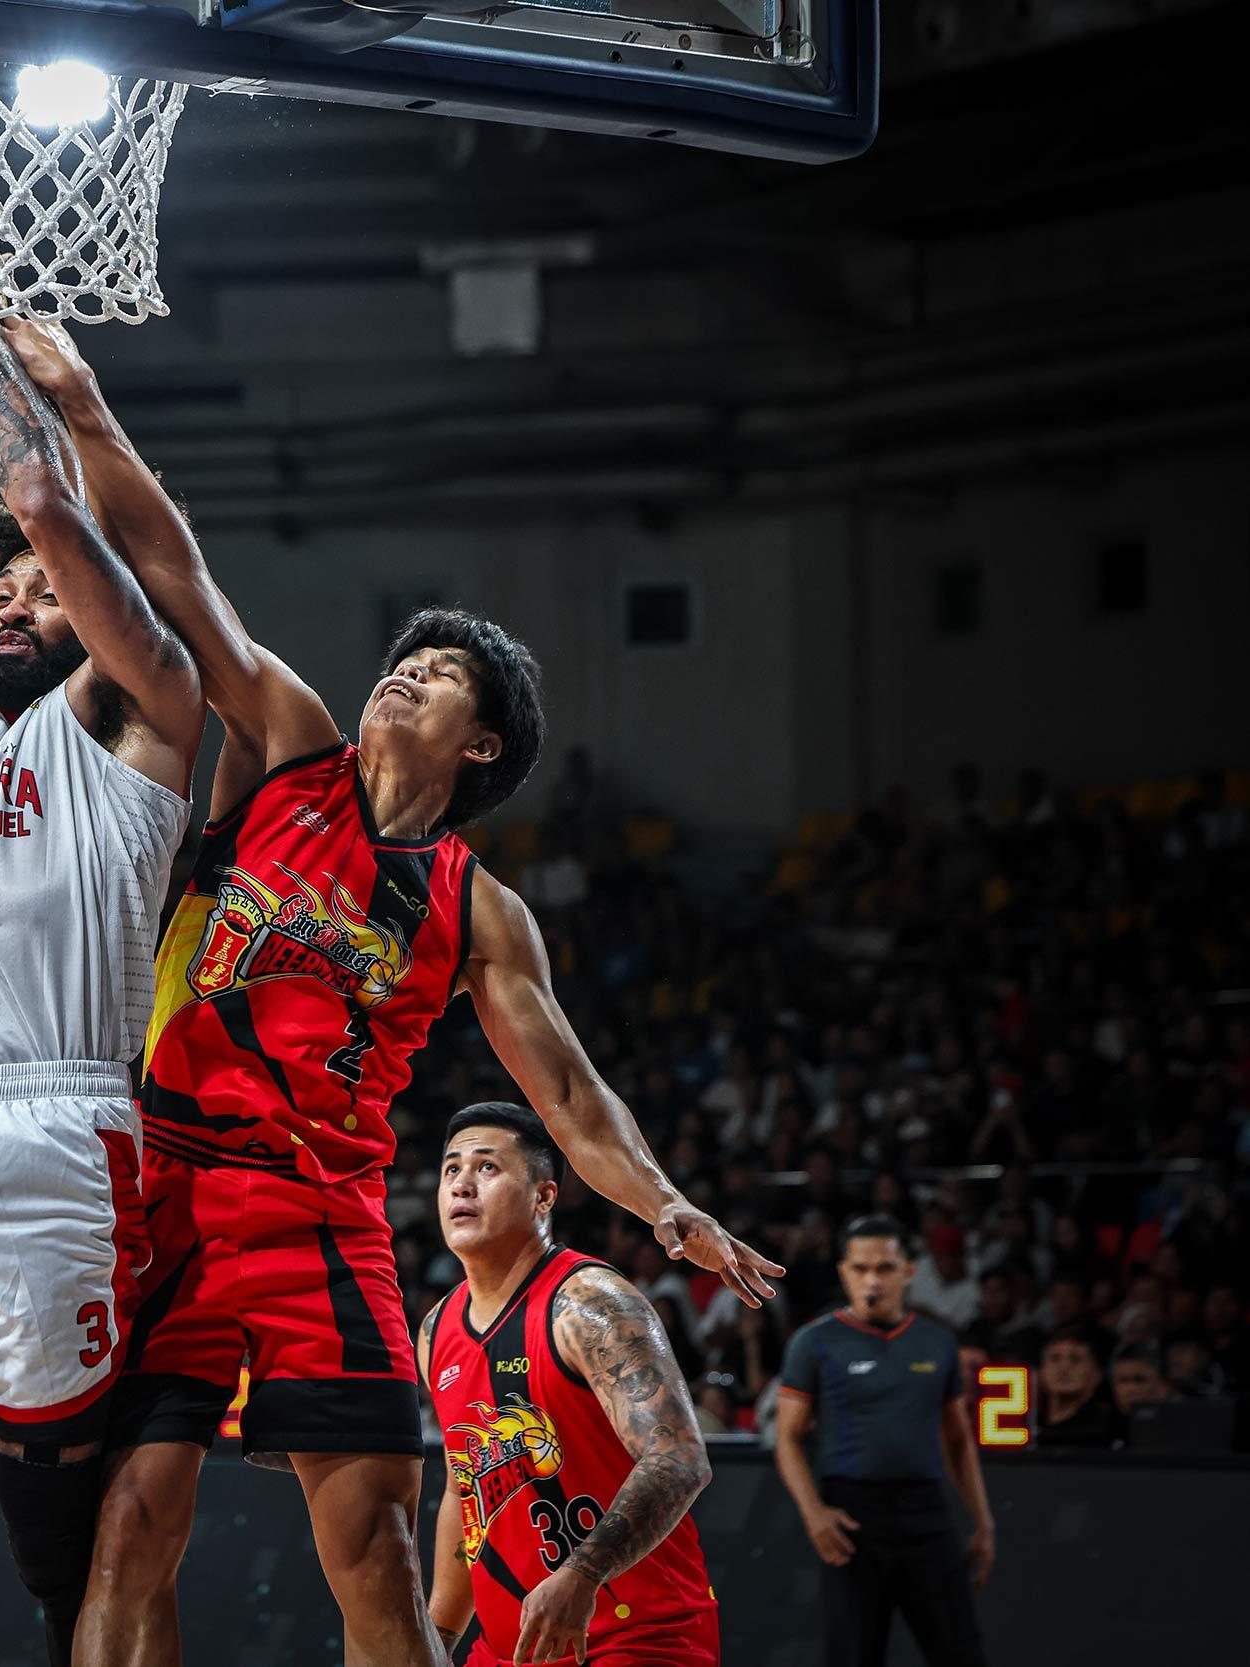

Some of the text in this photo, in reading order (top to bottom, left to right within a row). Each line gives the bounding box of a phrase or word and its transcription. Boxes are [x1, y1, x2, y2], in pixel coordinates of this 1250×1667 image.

[248, 930, 367, 993] BEERMEN
[324, 1010, 376, 1085] 2
[76, 1300, 113, 1369] 3
[978, 1366, 1030, 1447] 2
[528, 1494, 607, 1574] 30
